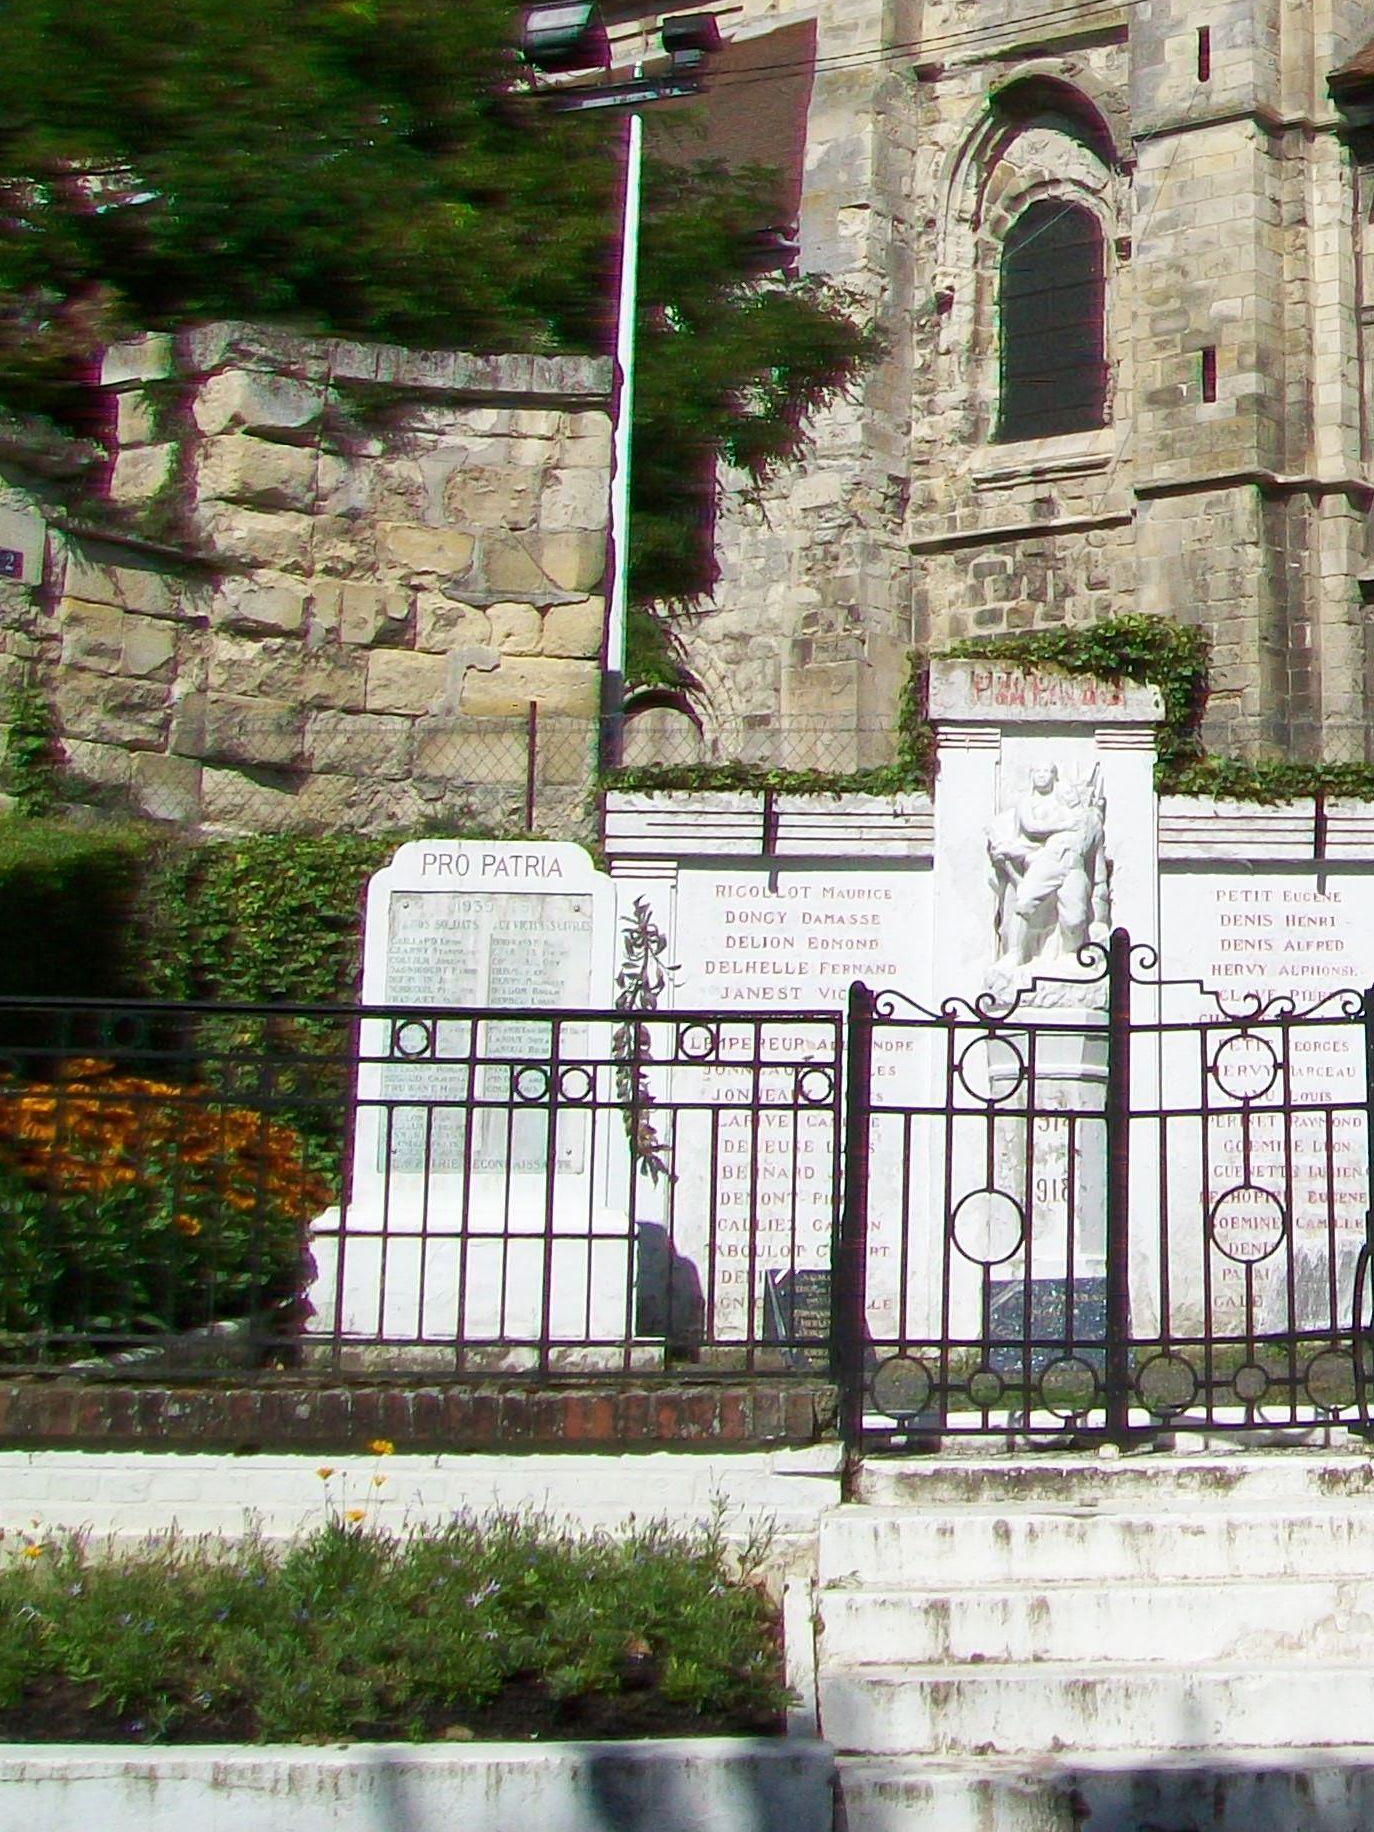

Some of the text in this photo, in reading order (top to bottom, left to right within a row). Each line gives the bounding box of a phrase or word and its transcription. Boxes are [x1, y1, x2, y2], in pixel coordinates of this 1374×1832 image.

[422, 853, 563, 878] PRO PATRIA
[822, 887, 893, 900] MAURICE
[1216, 889, 1272, 902] PETIT
[802, 911, 881, 925] DAMASSE
[1221, 914, 1336, 927] DENIS HENRI
[725, 936, 879, 950] DELION EDMOND
[1221, 939, 1344, 952] DENIS ALFRED
[705, 961, 897, 975] DELHELLE FERNAND
[1211, 964, 1267, 977] HERVY
[720, 986, 801, 1000] JANEST
[1287, 1040, 1350, 1053] EORGES
[1214, 1066, 1356, 1079] ERVY ARCEAU
[724, 1139, 814, 1154] DEEUE
[1223, 1140, 1351, 1154] GOEMIE LON
[722, 1166, 815, 1180] BENAD
[1309, 1166, 1363, 1179] LUIEN
[1307, 1191, 1367, 1204] EUENE
[1211, 1216, 1364, 1230] OEMINE CAMLLE
